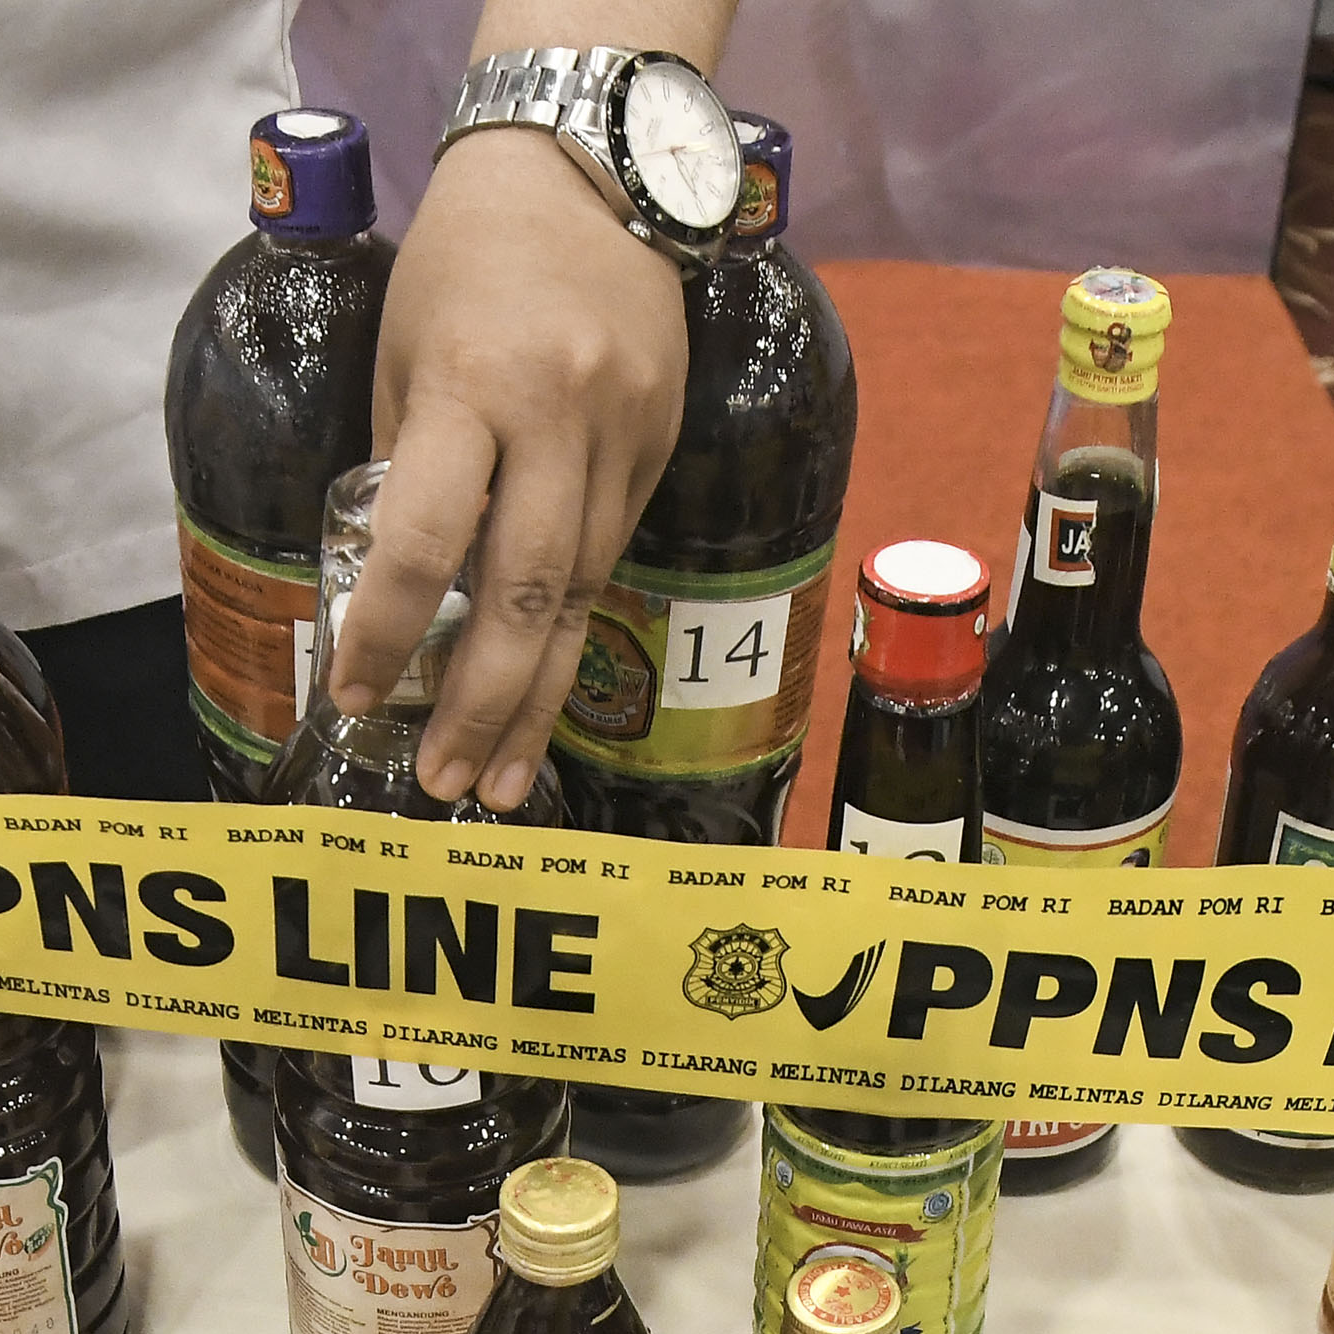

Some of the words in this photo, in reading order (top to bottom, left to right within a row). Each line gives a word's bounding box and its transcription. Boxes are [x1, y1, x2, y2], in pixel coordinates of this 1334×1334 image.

[678, 619, 770, 683] 14
[228, 828, 304, 843] BADAN
[321, 833, 365, 853] POM
[380, 842, 409, 858] RI
[272, 876, 599, 1014] LINE
[887, 940, 1302, 1064] PPNS
[901, 1075, 1016, 1098] DILARANG
[1030, 1084, 1144, 1105] MELINTAS
[351, 1242, 459, 1275] Jamu
